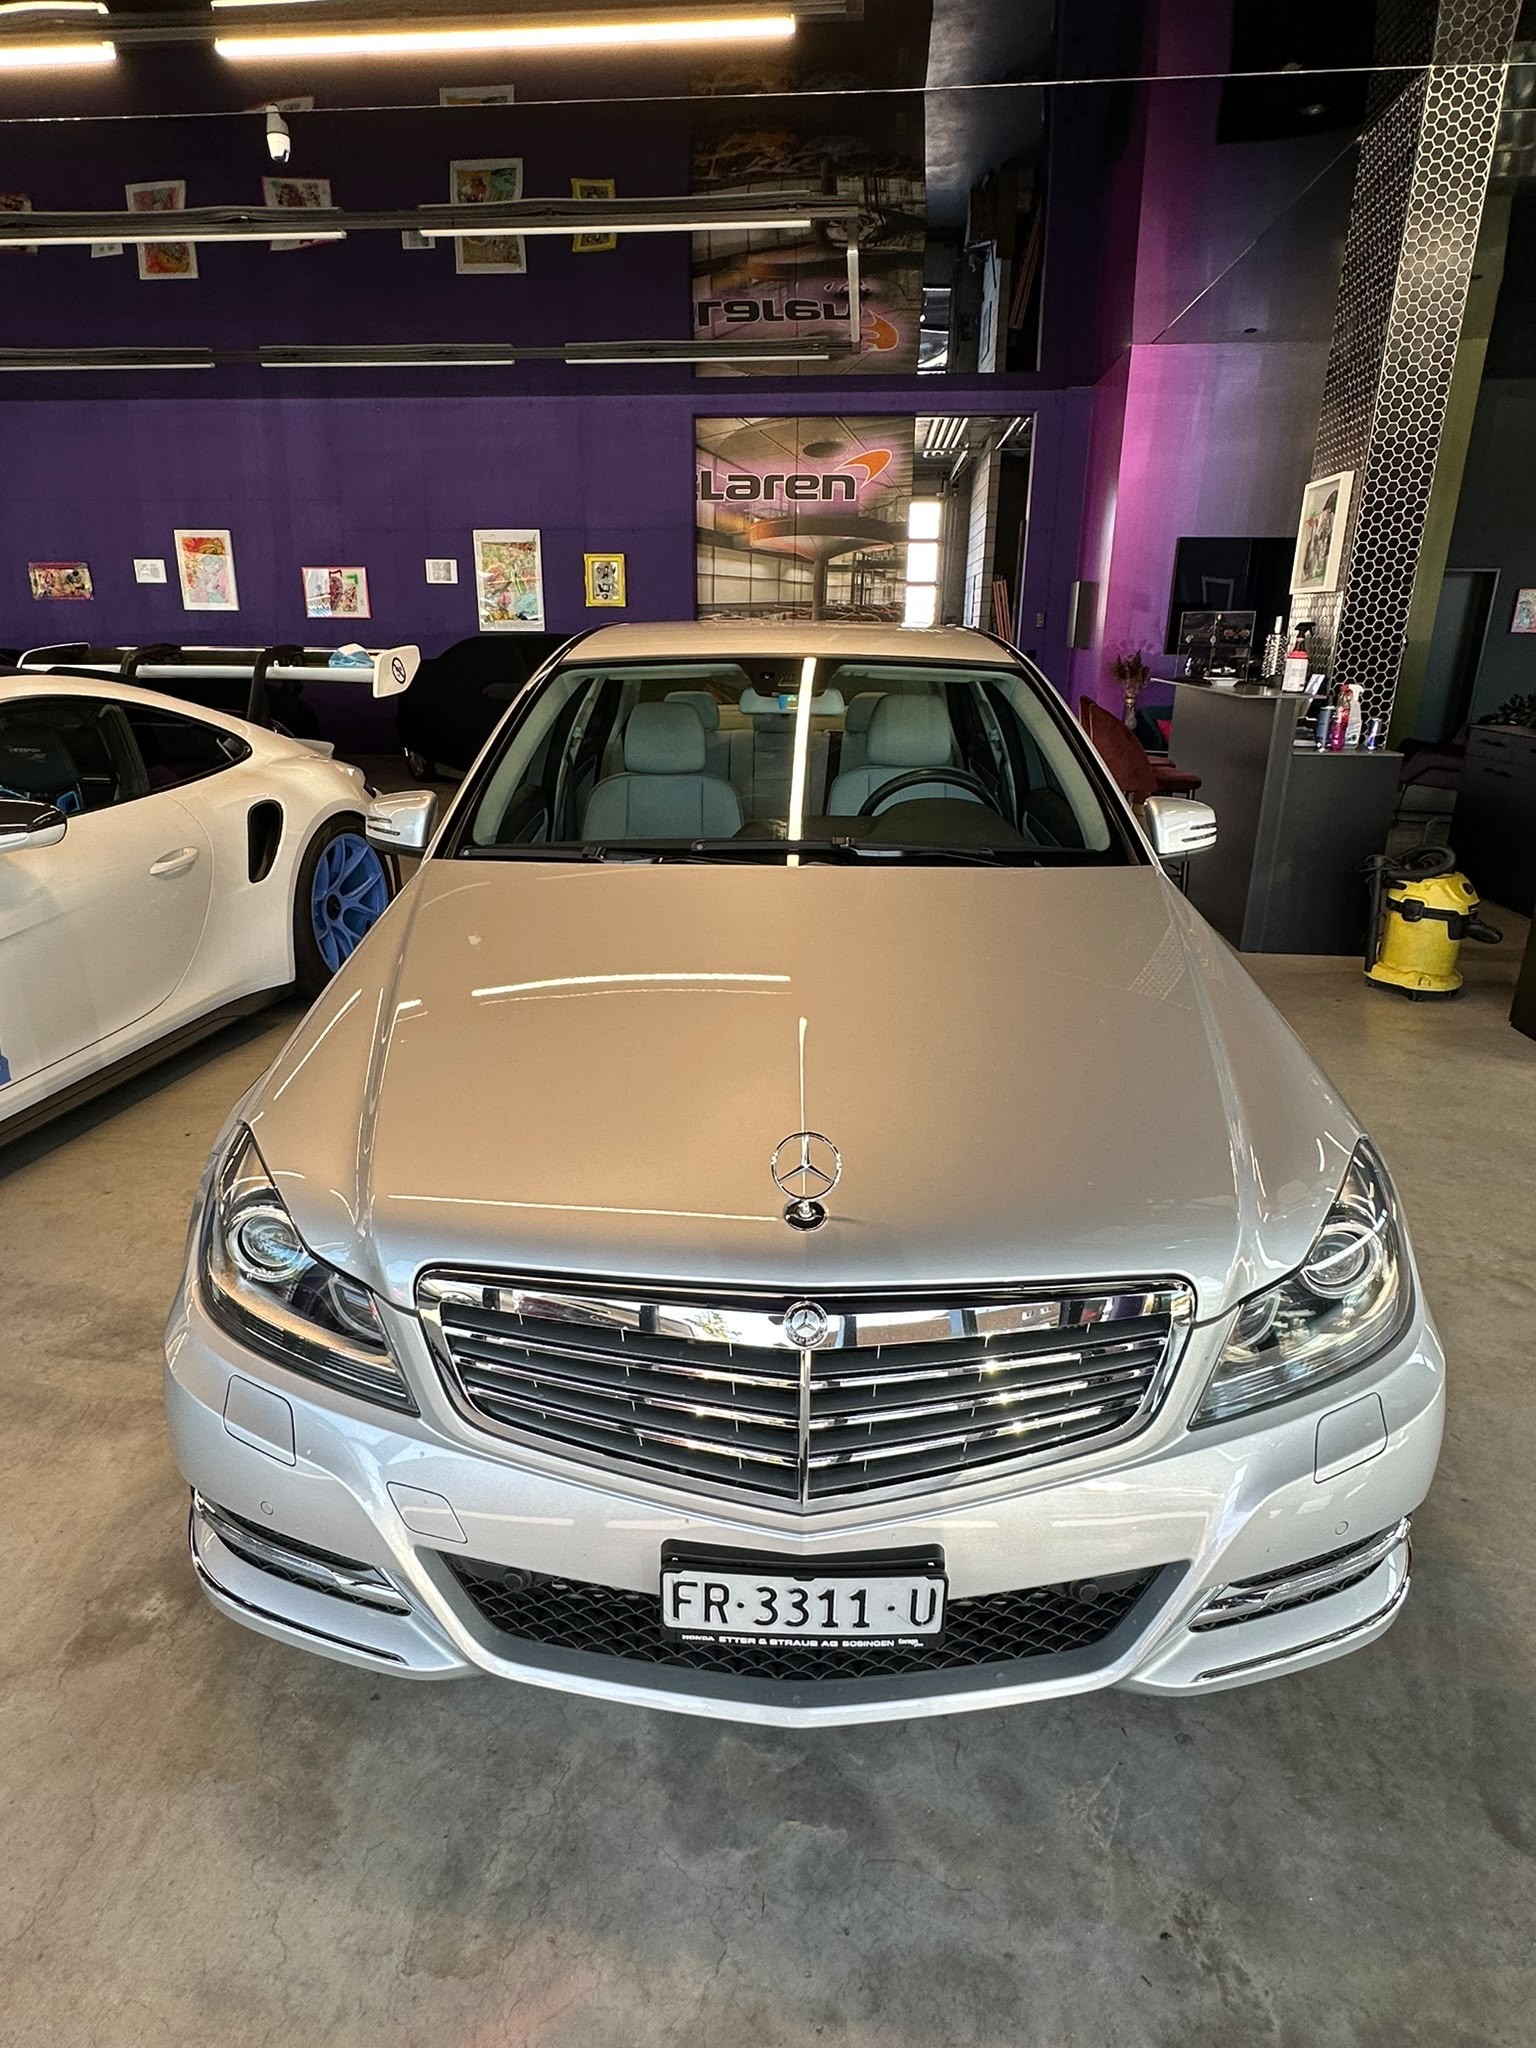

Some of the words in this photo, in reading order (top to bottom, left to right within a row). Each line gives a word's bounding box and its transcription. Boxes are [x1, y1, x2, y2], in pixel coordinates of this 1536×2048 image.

[700, 470, 856, 501] Laren
[681, 1634, 716, 1642] HONDA
[718, 1635, 756, 1645] ETTER
[758, 1637, 768, 1646] &
[769, 1638, 819, 1647] STRAUB
[820, 1640, 839, 1648] AG
